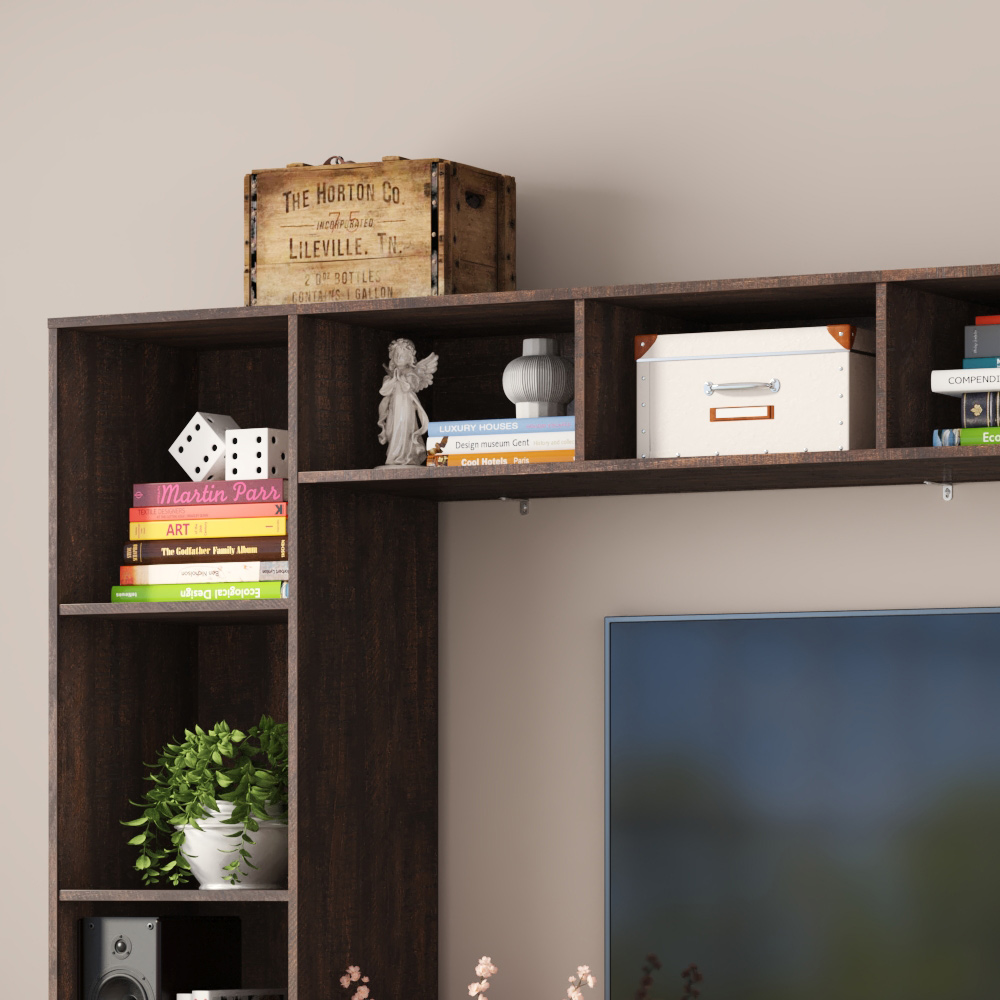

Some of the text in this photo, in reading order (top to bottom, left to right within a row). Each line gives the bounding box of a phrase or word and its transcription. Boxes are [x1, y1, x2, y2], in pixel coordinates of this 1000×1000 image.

[282, 189, 310, 213] THE
[317, 182, 375, 205] HORTON
[334, 270, 381, 285] BOTTLES
[355, 286, 393, 300] GALLON
[439, 421, 518, 433] LUXURY HOUSES
[455, 438, 530, 451] Design museum Gent
[461, 456, 530, 466] Cool Hotels Paris
[160, 481, 281, 505] Martin Parr
[166, 523, 190, 536] ART
[161, 545, 258, 557] The Godfather Family Album
[180, 586, 261, 599] Ecological Design
